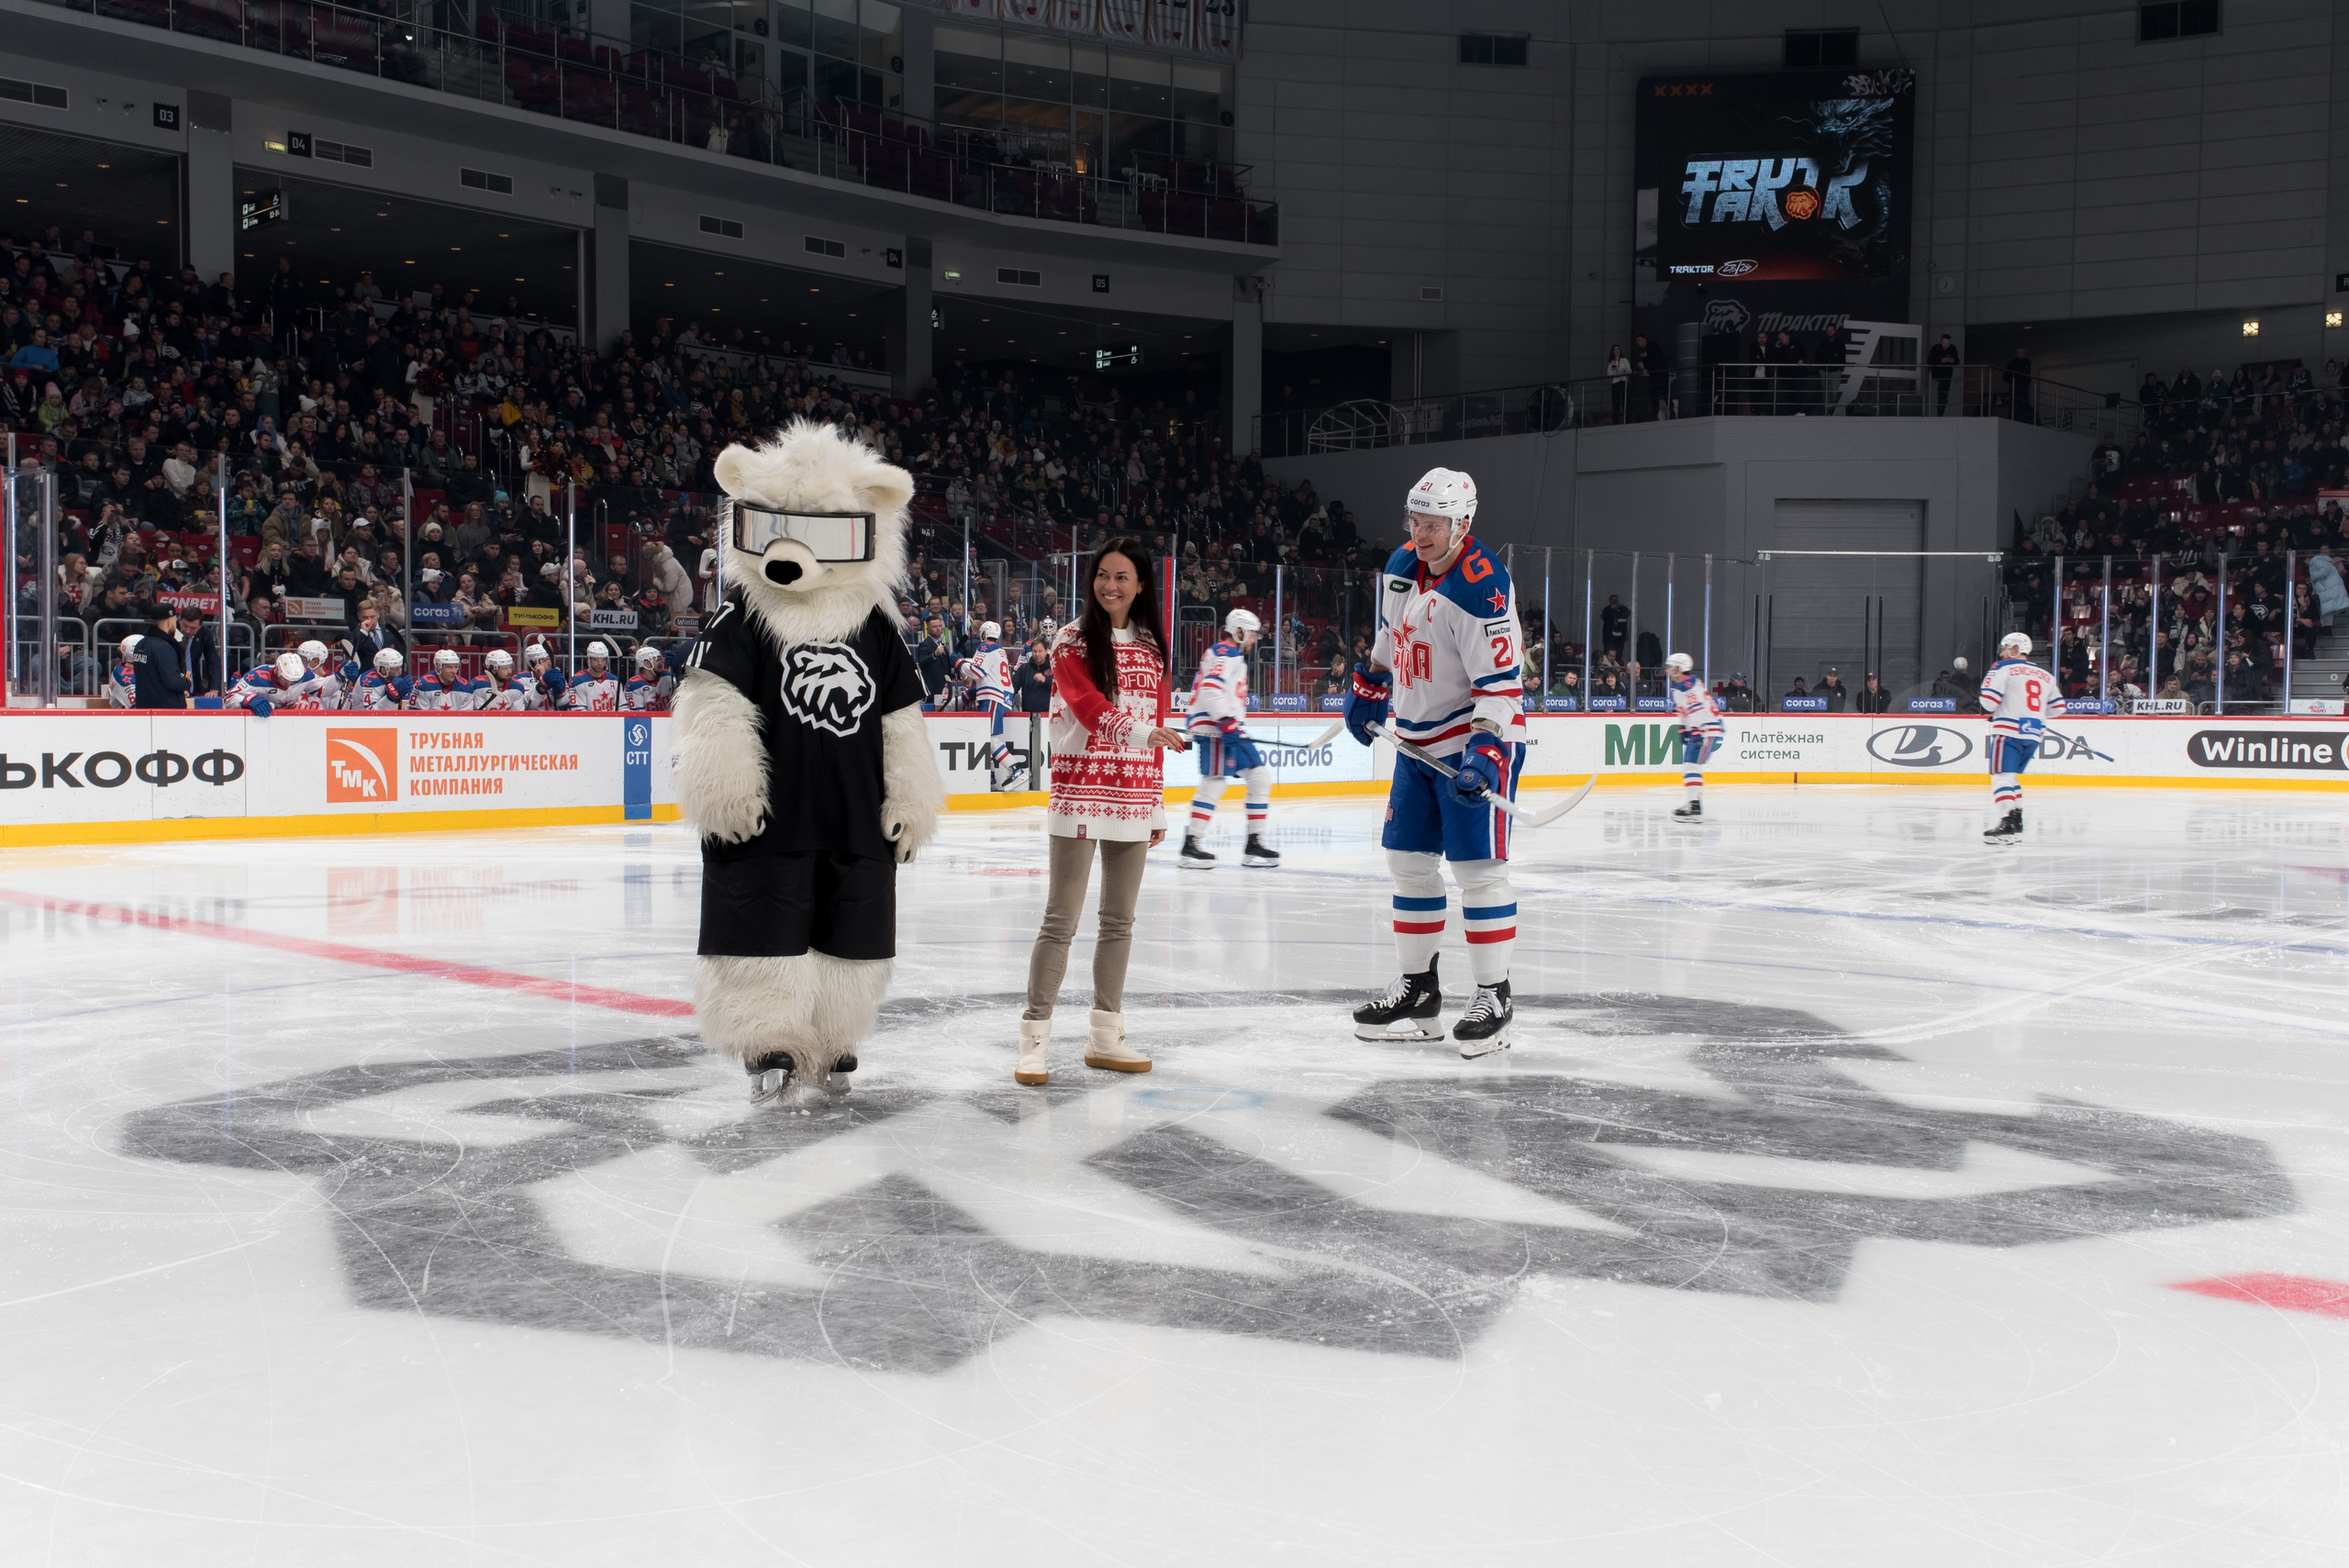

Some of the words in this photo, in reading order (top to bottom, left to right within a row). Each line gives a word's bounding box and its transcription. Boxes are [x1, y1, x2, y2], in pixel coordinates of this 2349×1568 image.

[1670, 265, 1714, 274] TRAKTOR
[1420, 482, 1433, 492] 21
[1410, 498, 1431, 507] согаз
[414, 607, 450, 617] согаз
[593, 612, 637, 626] KHL.RU
[1000, 661, 1012, 687] 9
[1273, 697, 1297, 706] согаз
[2025, 679, 2042, 713] 8
[1545, 699, 1568, 707] согаз
[1592, 699, 1617, 707] согаз
[1786, 699, 1816, 707] согаз
[1911, 700, 1943, 708] согаз
[2066, 702, 2101, 710] согаз
[2136, 701, 2183, 710] KHL.RU
[409, 732, 484, 750] ТРУБНАЯ
[1741, 731, 1824, 744] Платёжная
[1260, 743, 1333, 767] ралсиб
[1740, 749, 1800, 760] система
[2201, 736, 2333, 763] Winline
[409, 754, 578, 773] МЕТАЛЛУРГИЧЕСКАЯ
[626, 751, 650, 765] СТТ
[331, 760, 377, 797] ТМК
[409, 778, 503, 796] КОМПАНИЯ
